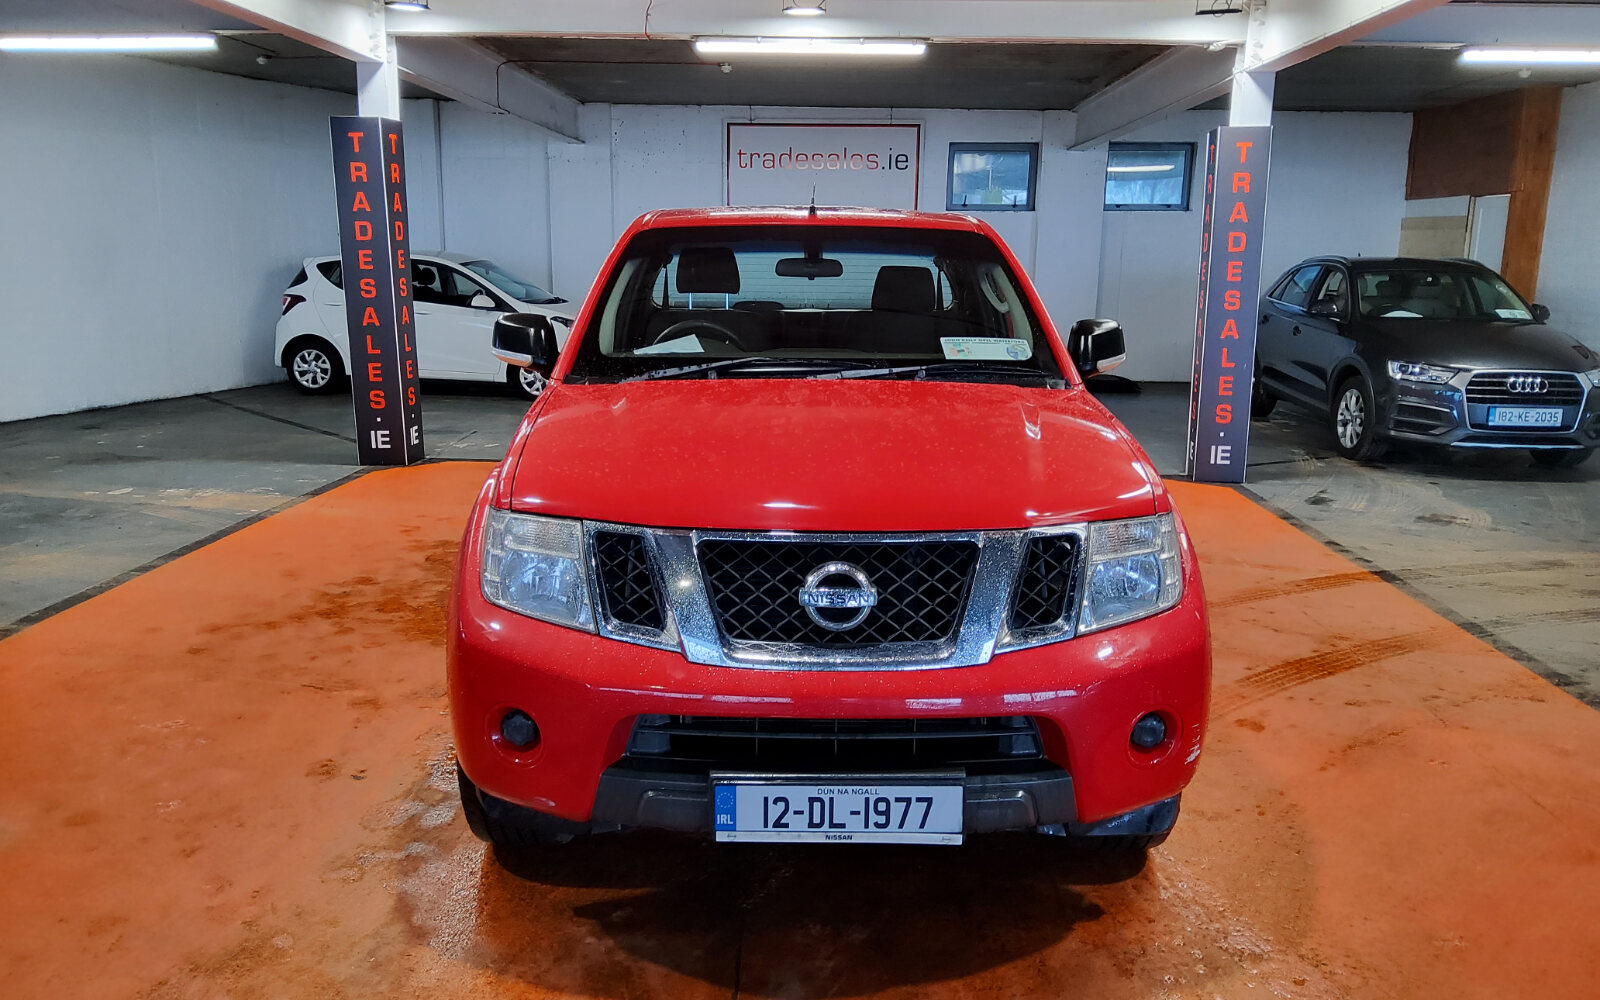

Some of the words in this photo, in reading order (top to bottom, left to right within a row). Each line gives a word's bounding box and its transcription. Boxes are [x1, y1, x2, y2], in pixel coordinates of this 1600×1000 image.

[737, 147, 909, 170] tradesales.ie
[1498, 411, 1559, 422] 182-KE-2035
[808, 593, 870, 604] NISSAN
[851, 788, 880, 796] NGALL
[763, 796, 934, 829] 12-DL-1977
[716, 814, 734, 825] IRL
